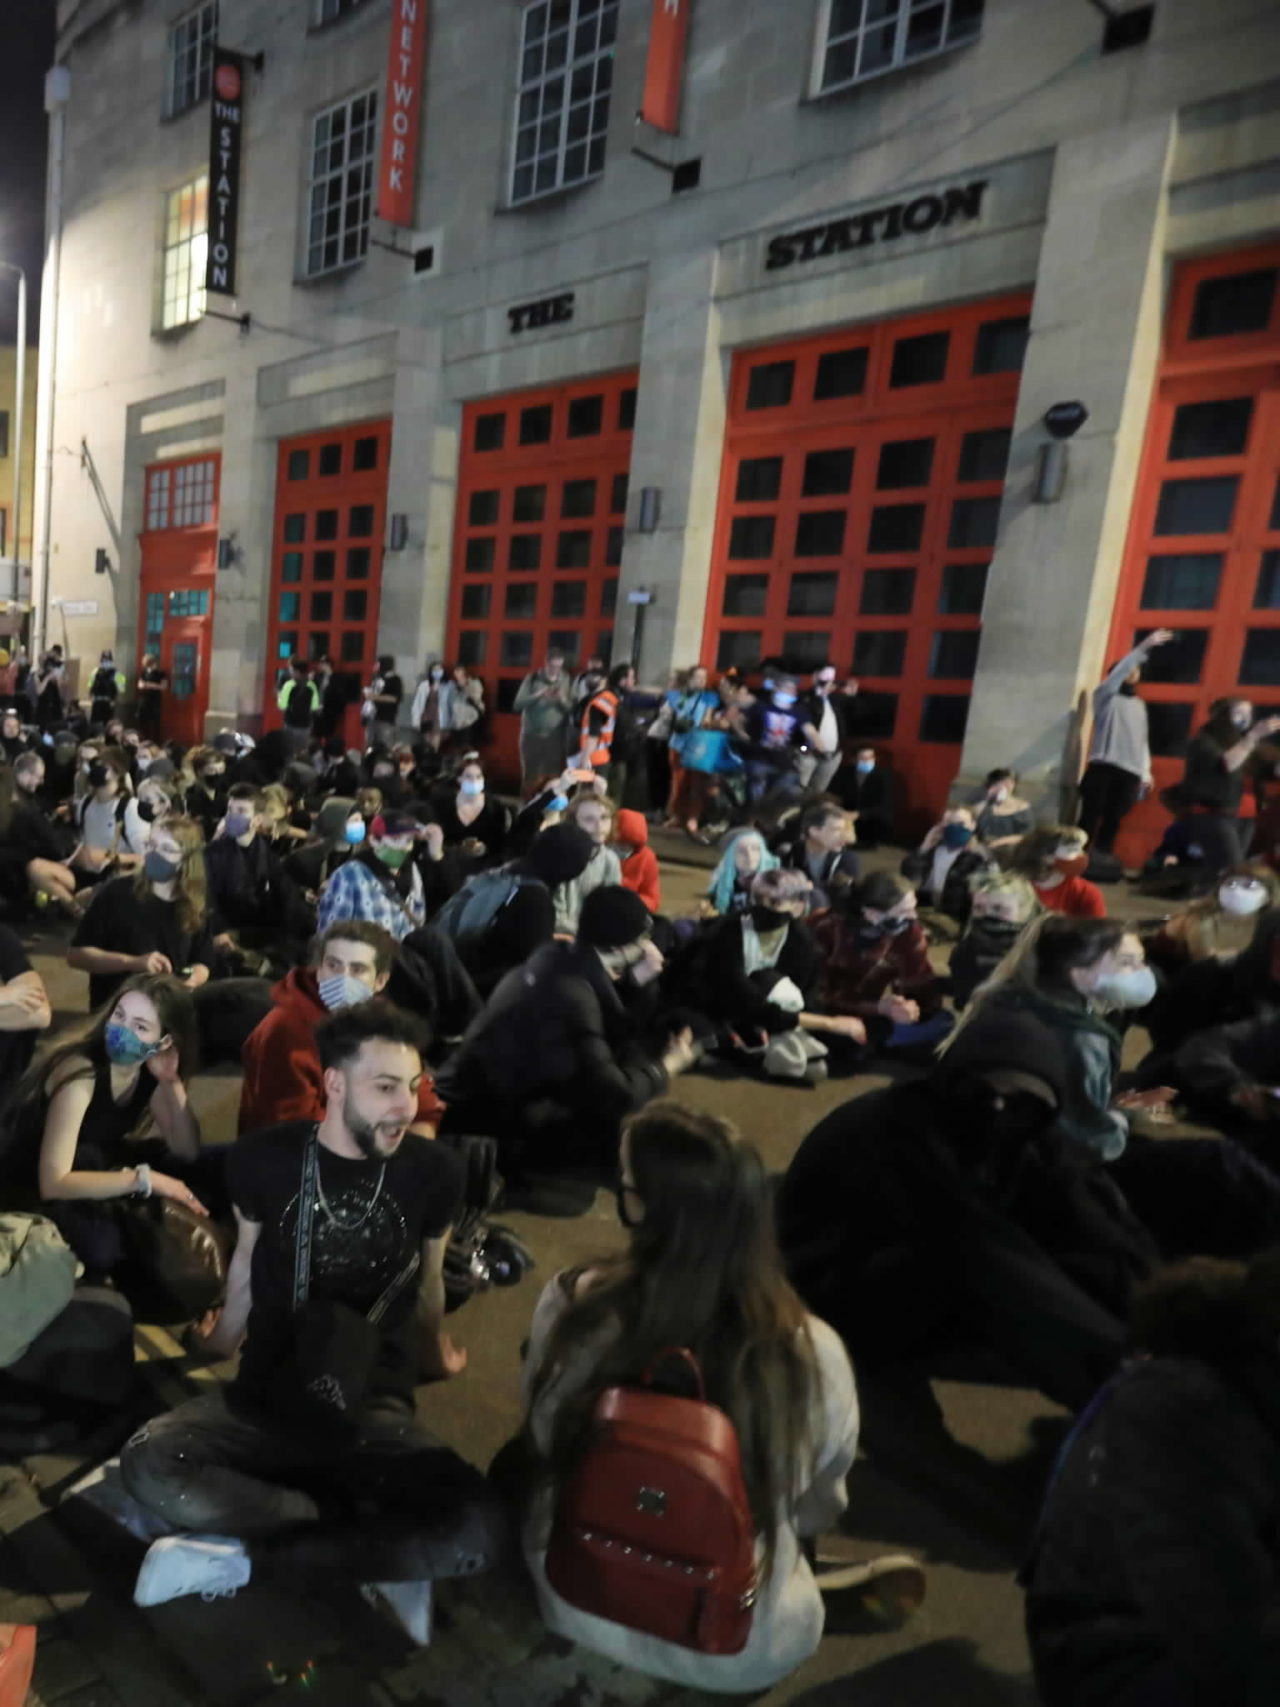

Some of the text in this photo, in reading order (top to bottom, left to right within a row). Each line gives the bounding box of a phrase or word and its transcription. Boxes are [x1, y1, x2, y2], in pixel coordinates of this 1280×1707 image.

[215, 102, 240, 123] THE
[389, 0, 417, 192] NETWORK
[213, 127, 231, 286] STATION
[766, 180, 990, 271] STATION
[507, 292, 575, 334] THE
